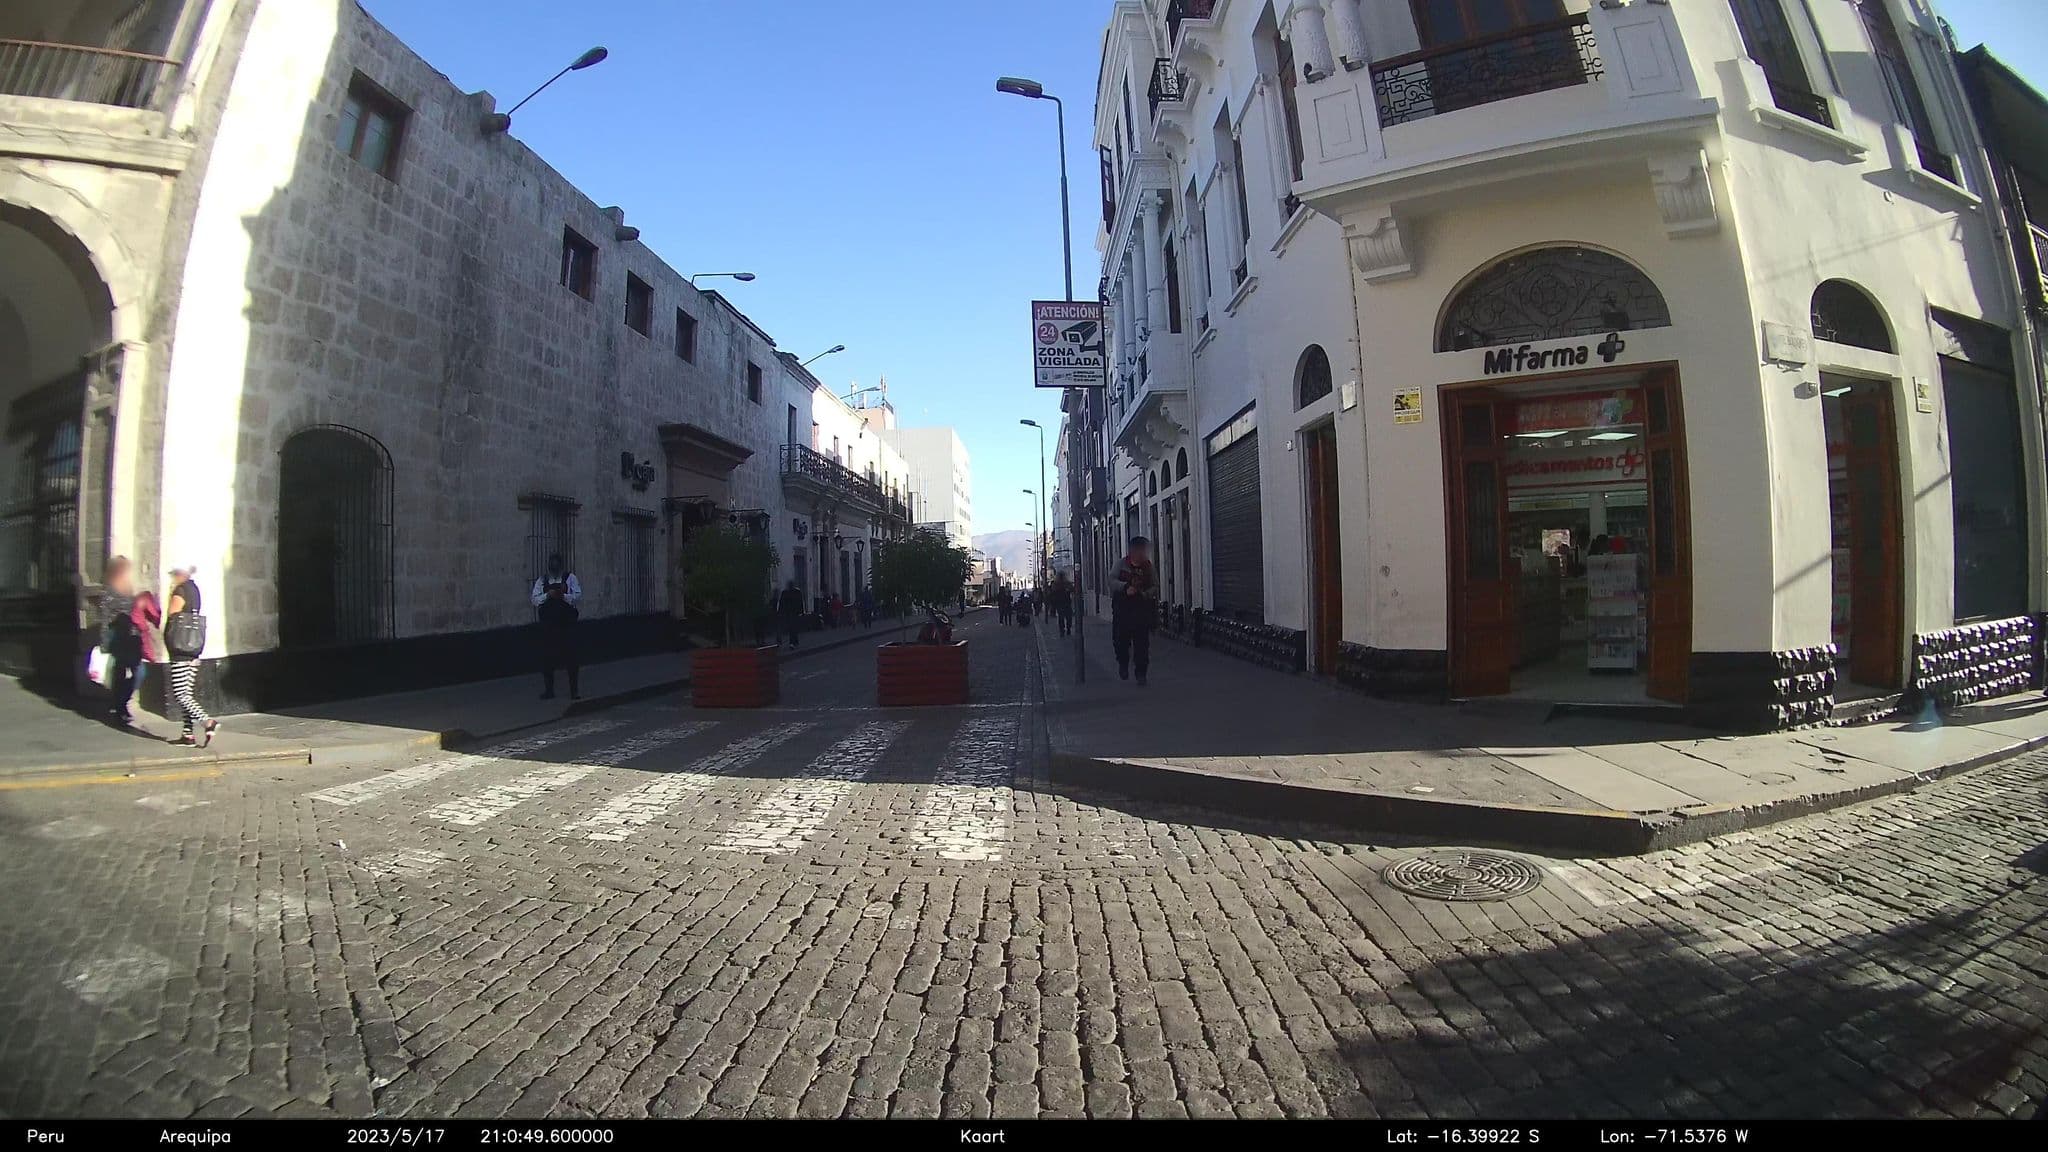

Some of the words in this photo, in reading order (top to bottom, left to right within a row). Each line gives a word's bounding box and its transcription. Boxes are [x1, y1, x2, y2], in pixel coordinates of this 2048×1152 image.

[1037, 304, 1099, 319] ¡ATENCIÓN!
[1040, 326, 1056, 337] 24
[1038, 348, 1075, 356] ZONA
[1039, 357, 1100, 366] VIGILADA
[1484, 345, 1588, 375] Mifarma
